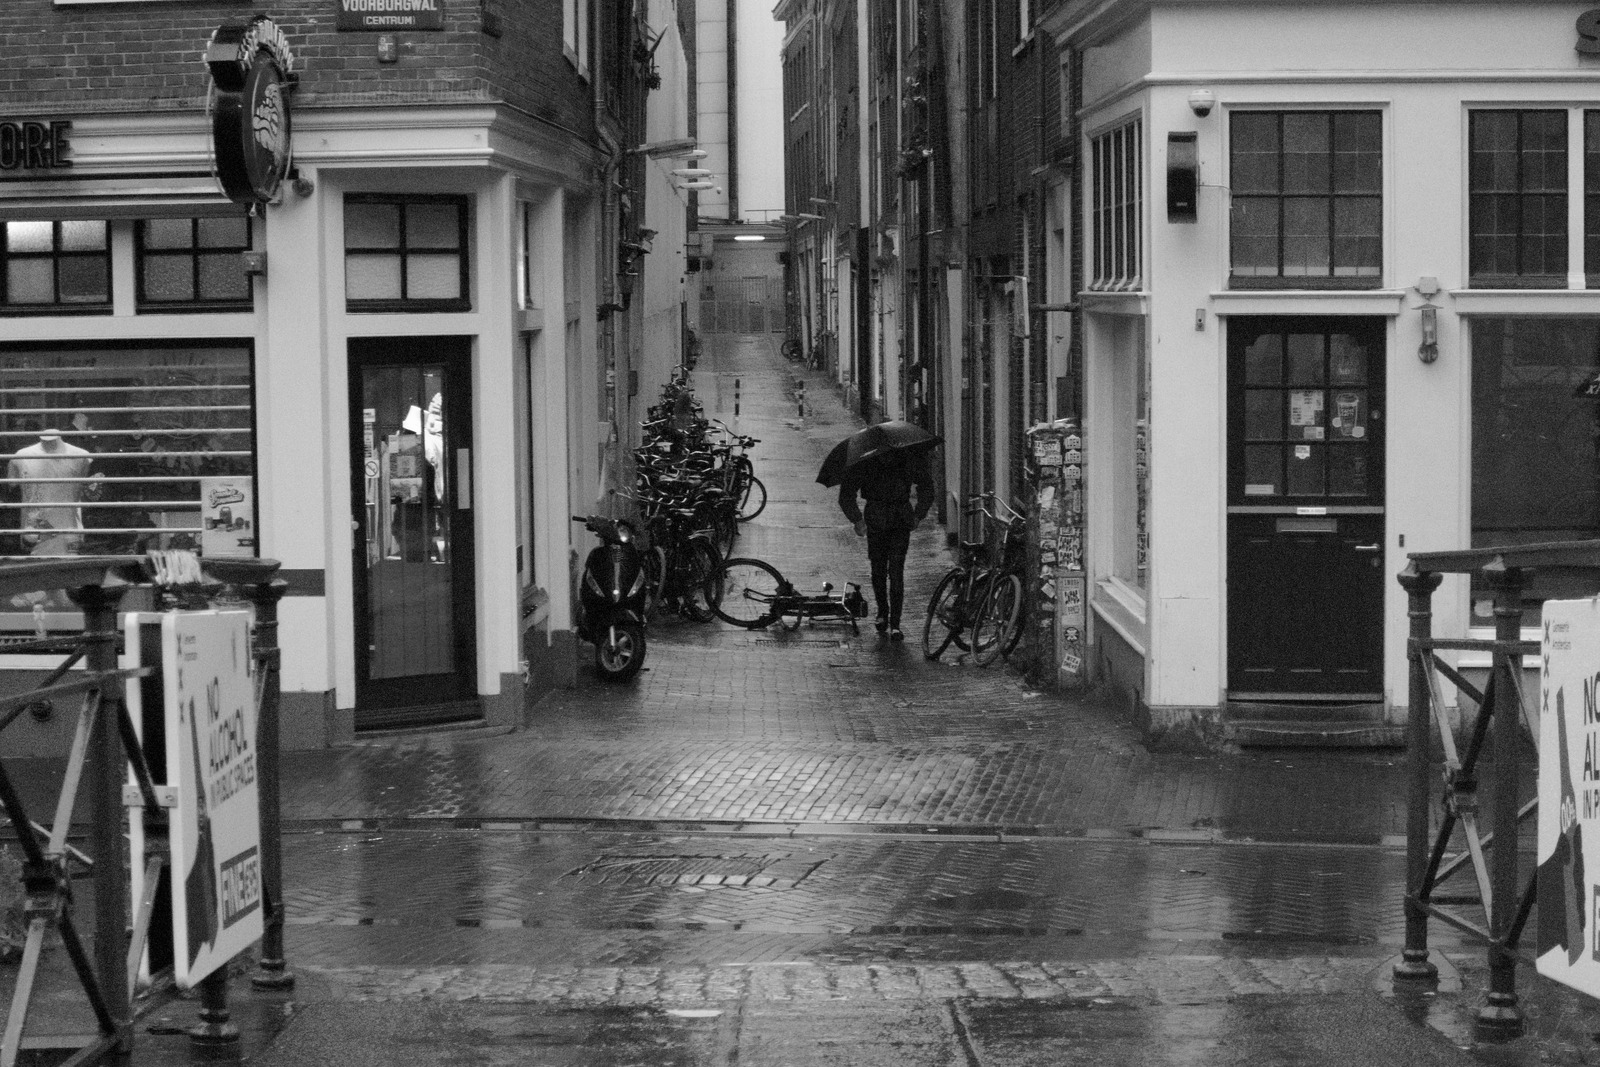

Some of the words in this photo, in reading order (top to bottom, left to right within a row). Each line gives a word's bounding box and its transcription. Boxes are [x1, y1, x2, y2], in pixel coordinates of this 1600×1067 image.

[342, 0, 438, 11] VOORBURGWAL
[362, 15, 416, 25] (CENTRUM)
[207, 676, 220, 727] NO
[210, 706, 249, 778] ALCOHOL
[1583, 789, 1592, 820] IN
